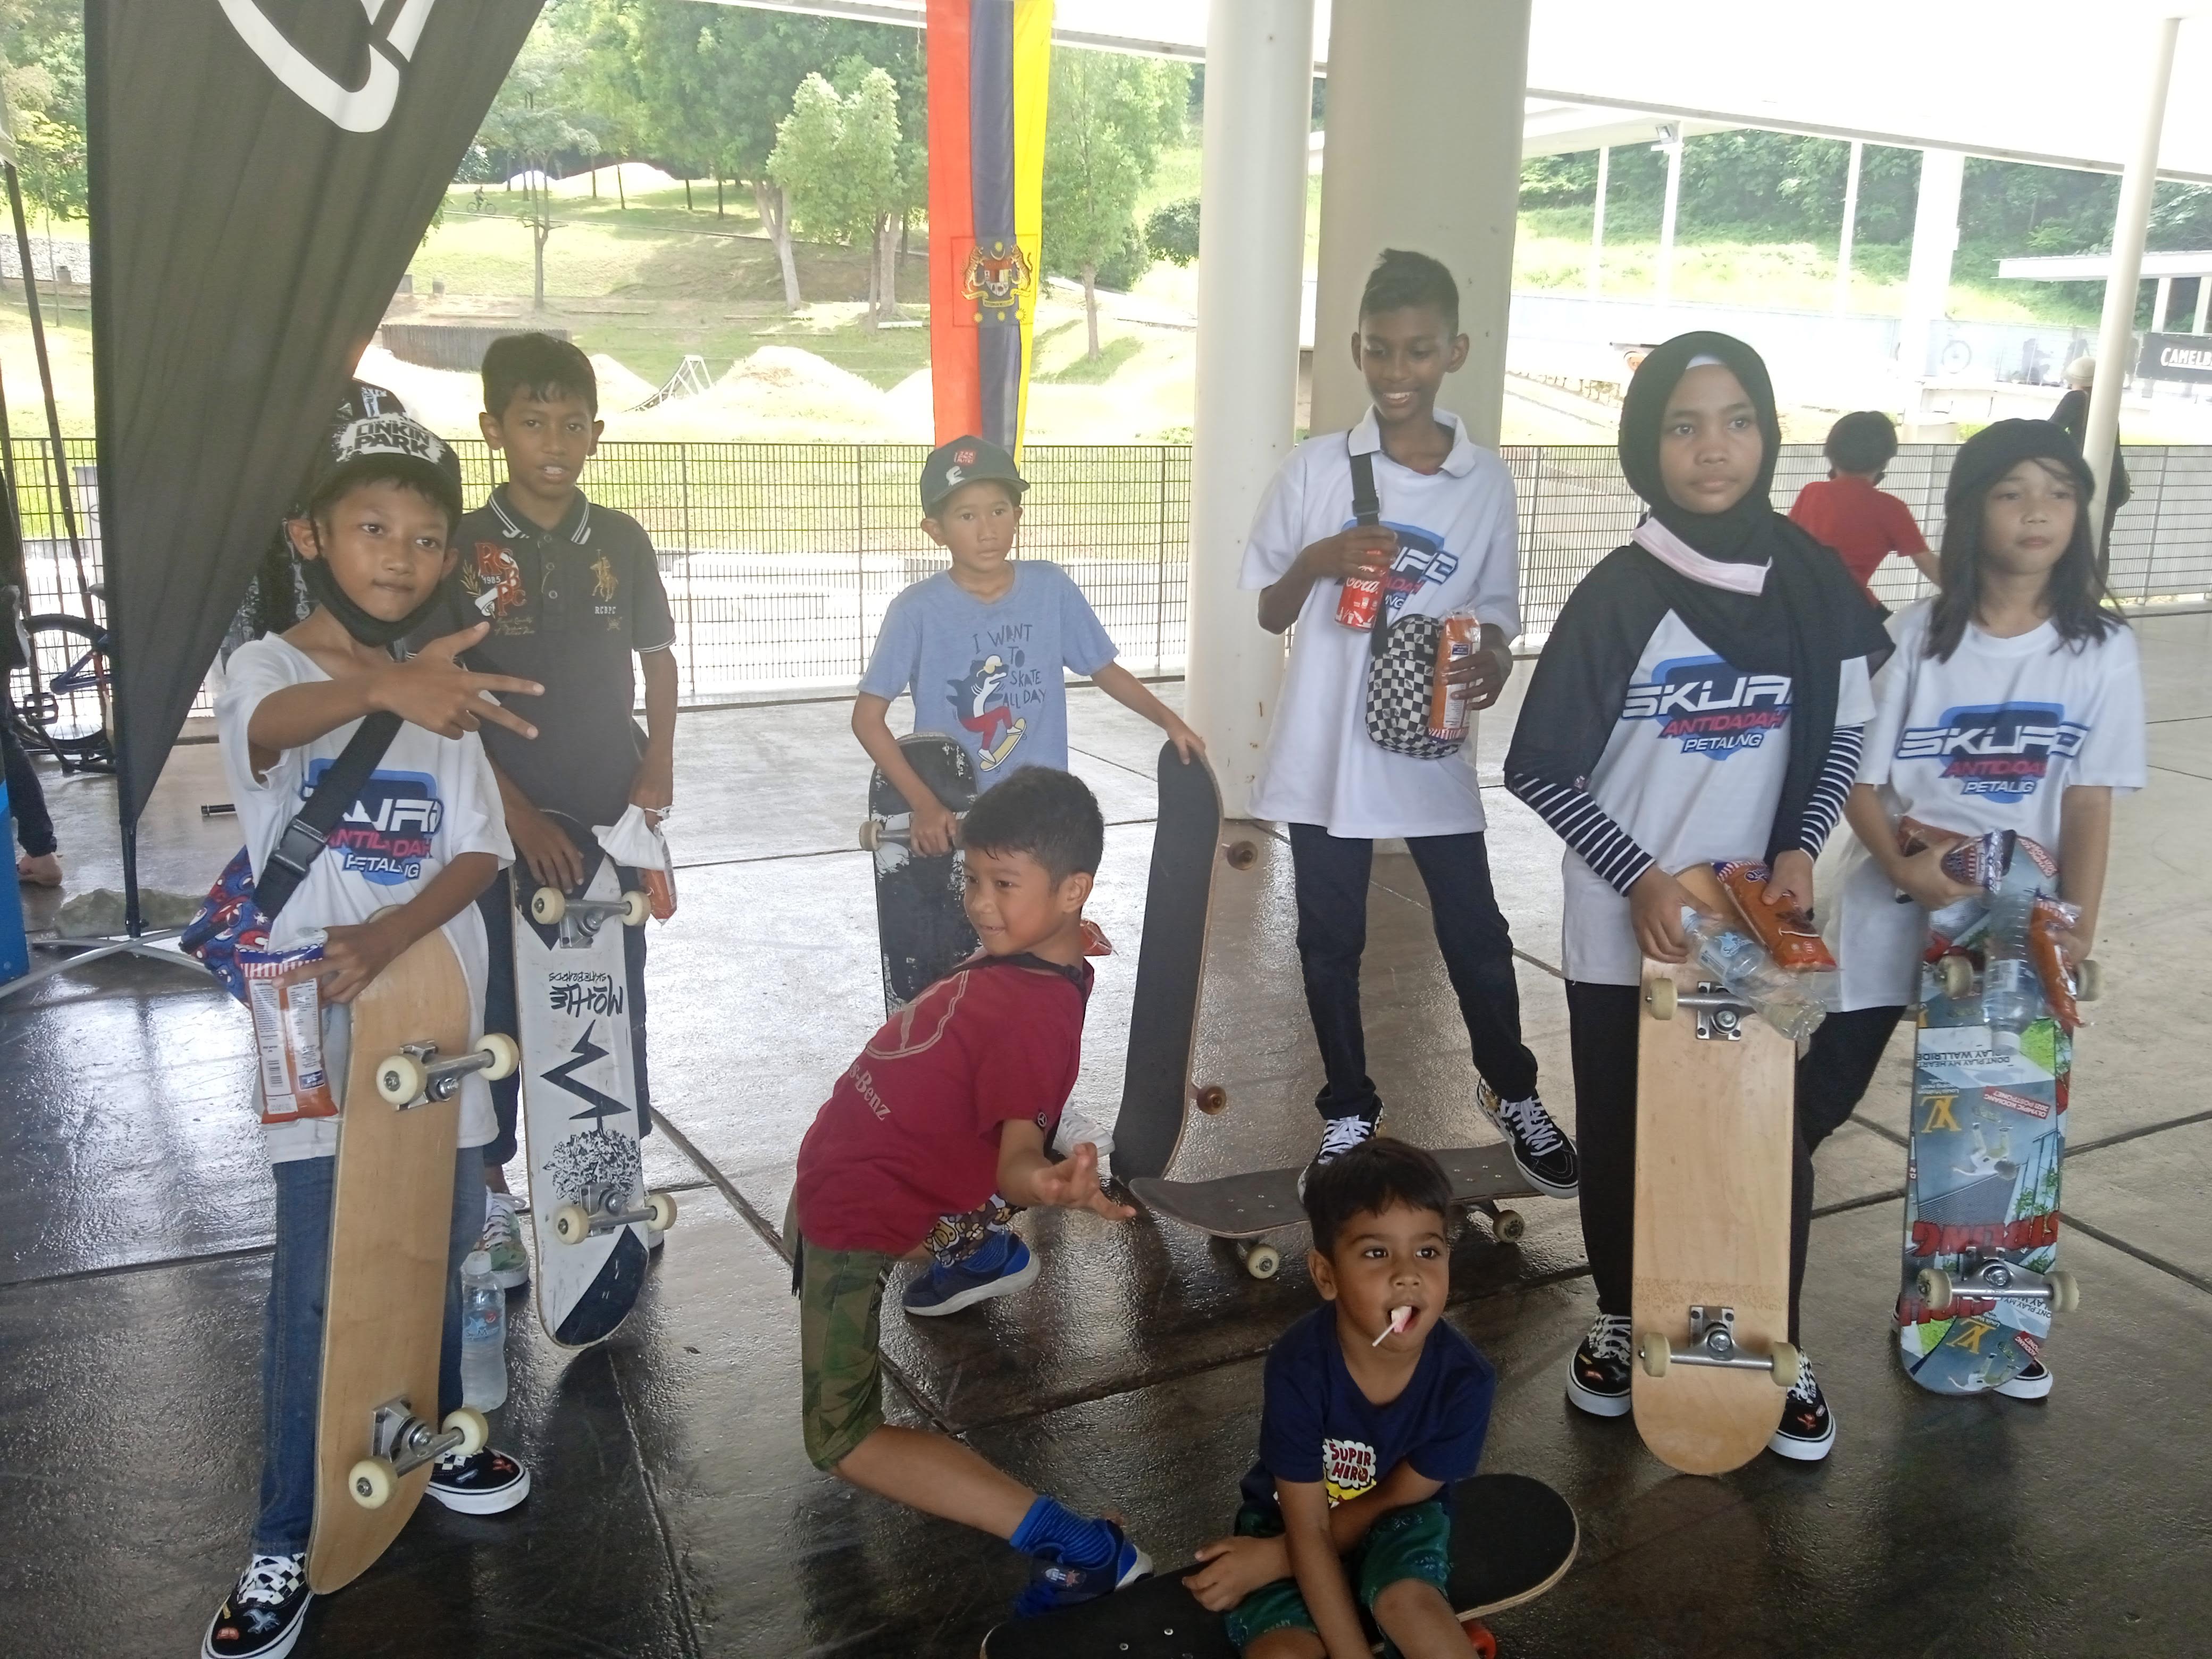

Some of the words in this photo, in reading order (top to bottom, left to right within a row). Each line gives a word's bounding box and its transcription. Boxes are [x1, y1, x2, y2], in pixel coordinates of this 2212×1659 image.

[2160, 348, 2212, 366] CAMELB
[356, 422, 430, 445] LINKIN
[355, 433, 432, 460] PARK
[481, 575, 501, 584] 1985
[972, 633, 981, 655] I
[987, 623, 1033, 647] WANT
[1007, 646, 1025, 668] TO
[1010, 669, 1042, 687] SKATE
[1003, 693, 1021, 709] ALL
[1024, 689, 1046, 704] DAY
[1622, 675, 1792, 718] SKUA
[1916, 1052, 1972, 1060] WALLRIDE
[2017, 1104, 2046, 1117] OLYMPIC
[2016, 1302, 2036, 1312] PLAY
